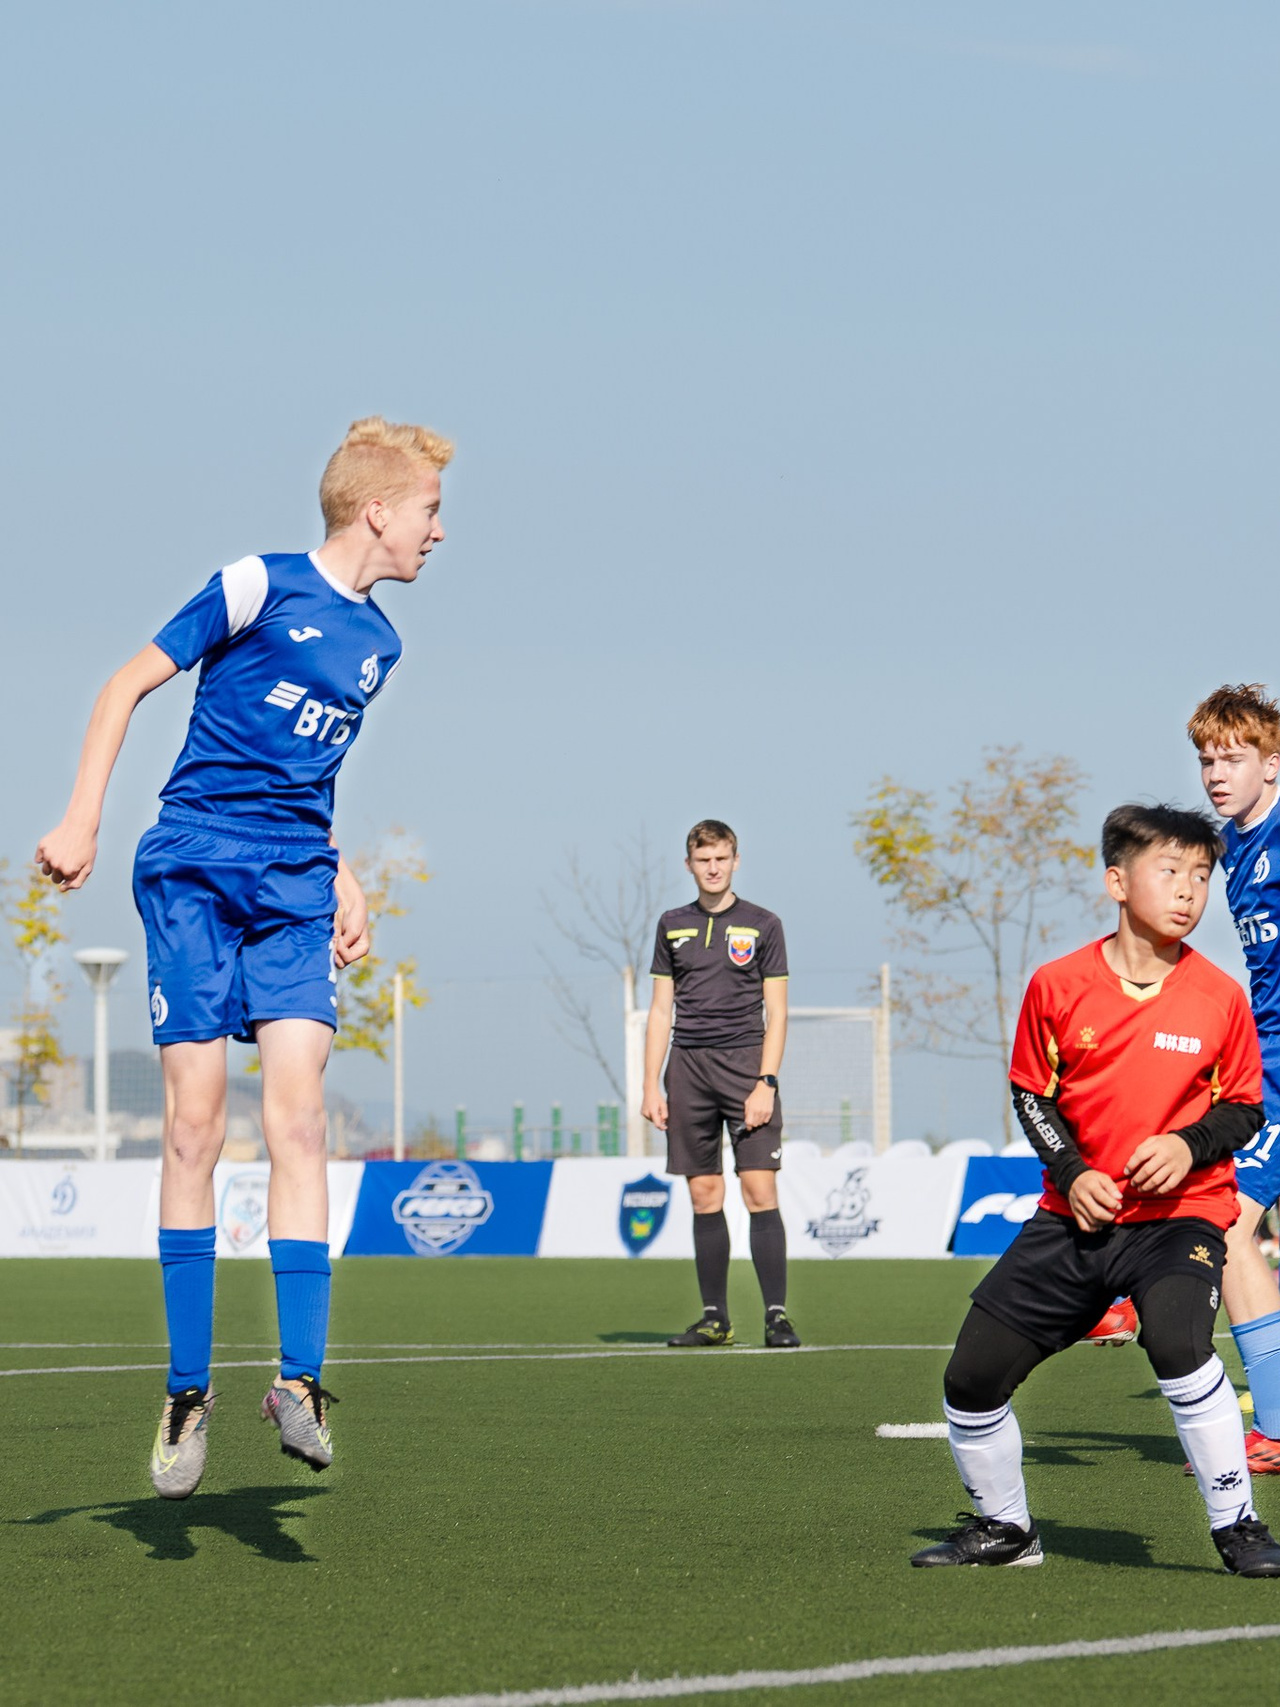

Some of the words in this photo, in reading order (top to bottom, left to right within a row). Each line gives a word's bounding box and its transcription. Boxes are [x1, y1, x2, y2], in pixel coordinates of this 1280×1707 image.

[293, 698, 359, 745] ВТБ
[1238, 911, 1279, 947] ВТБ
[1211, 1477, 1243, 1491] KELME
